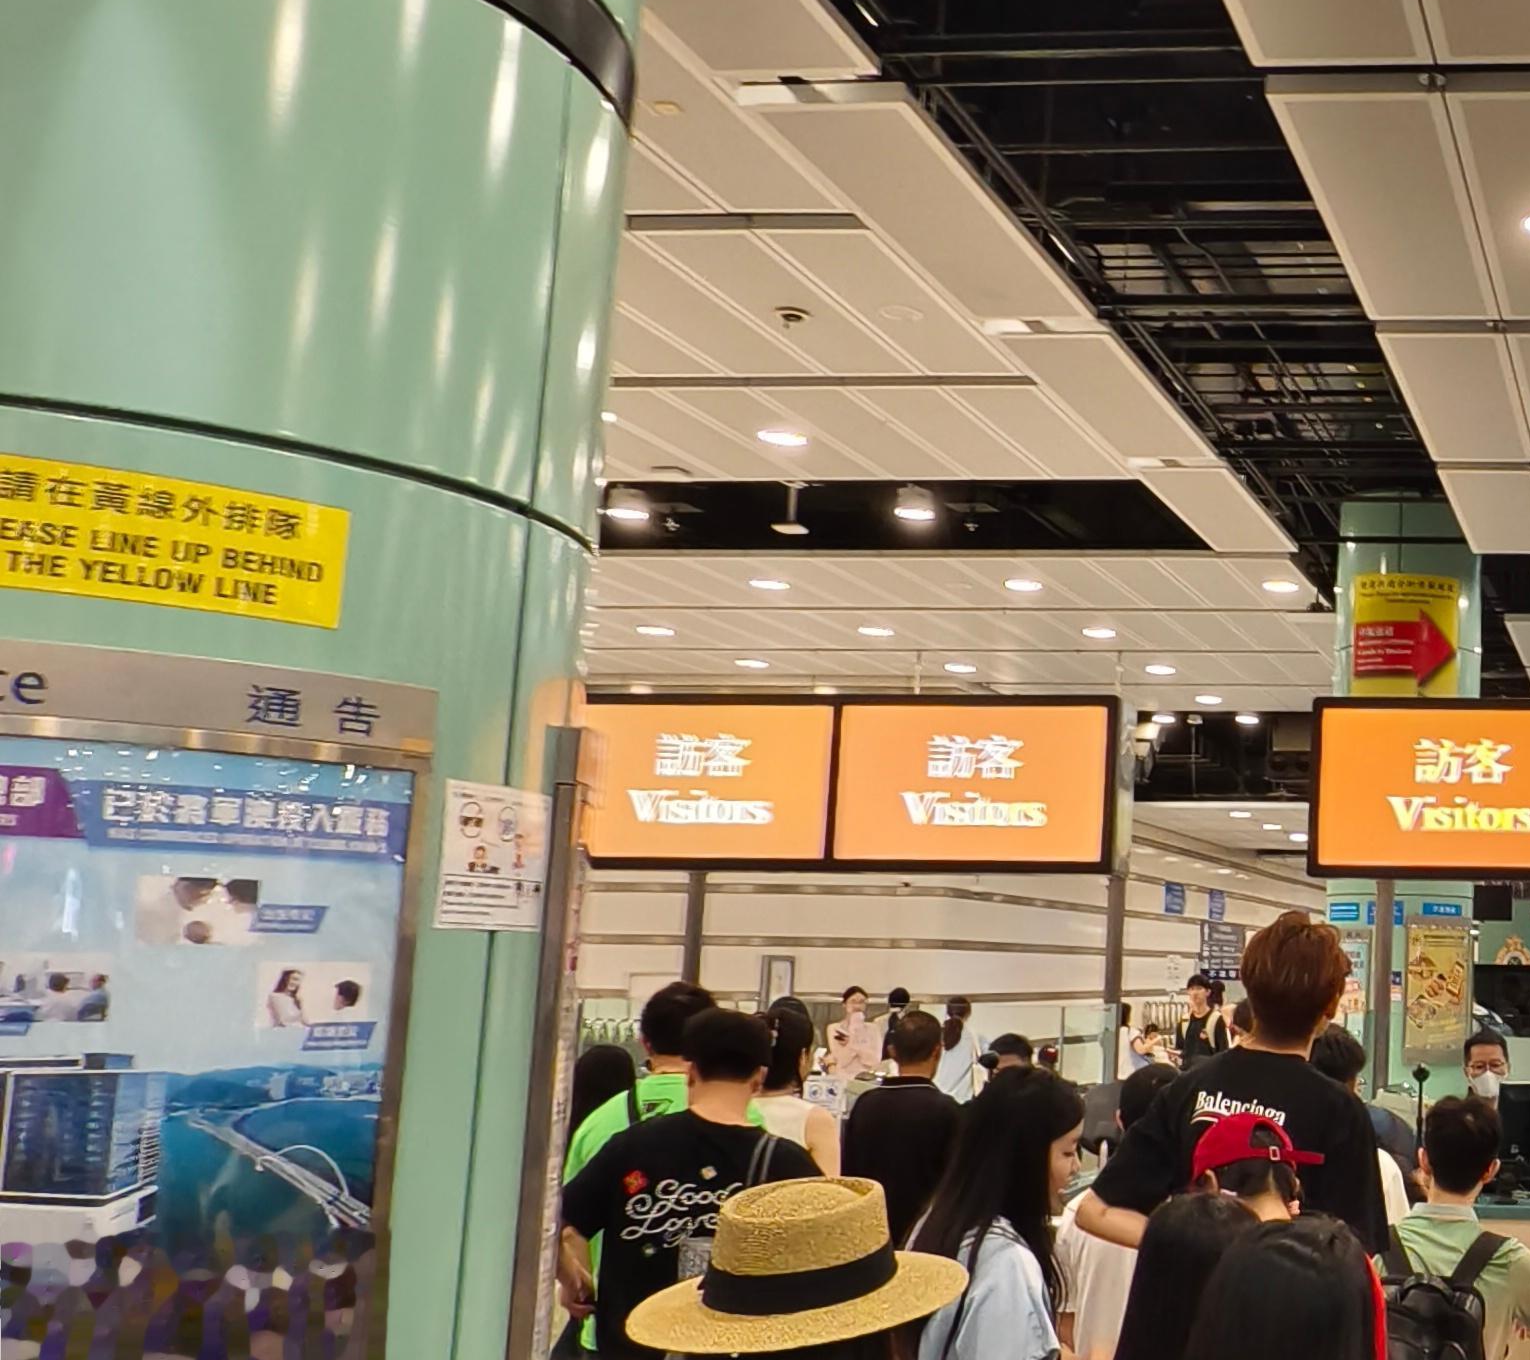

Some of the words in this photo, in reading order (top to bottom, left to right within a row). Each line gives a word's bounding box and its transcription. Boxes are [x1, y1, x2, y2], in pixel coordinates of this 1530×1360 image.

[5, 549, 68, 578] THE
[79, 558, 204, 594] YELLOW
[213, 576, 279, 606] LINE
[89, 528, 158, 558] LINE
[171, 540, 212, 565] UP
[221, 548, 324, 582] BEHIND
[0, 670, 48, 705] e
[247, 685, 381, 737] 通告
[655, 733, 751, 777] 訪客
[928, 734, 1024, 779] 訪客
[1414, 738, 1512, 784] 訪客
[627, 790, 774, 825] Visitors
[900, 792, 1047, 827] Visitors
